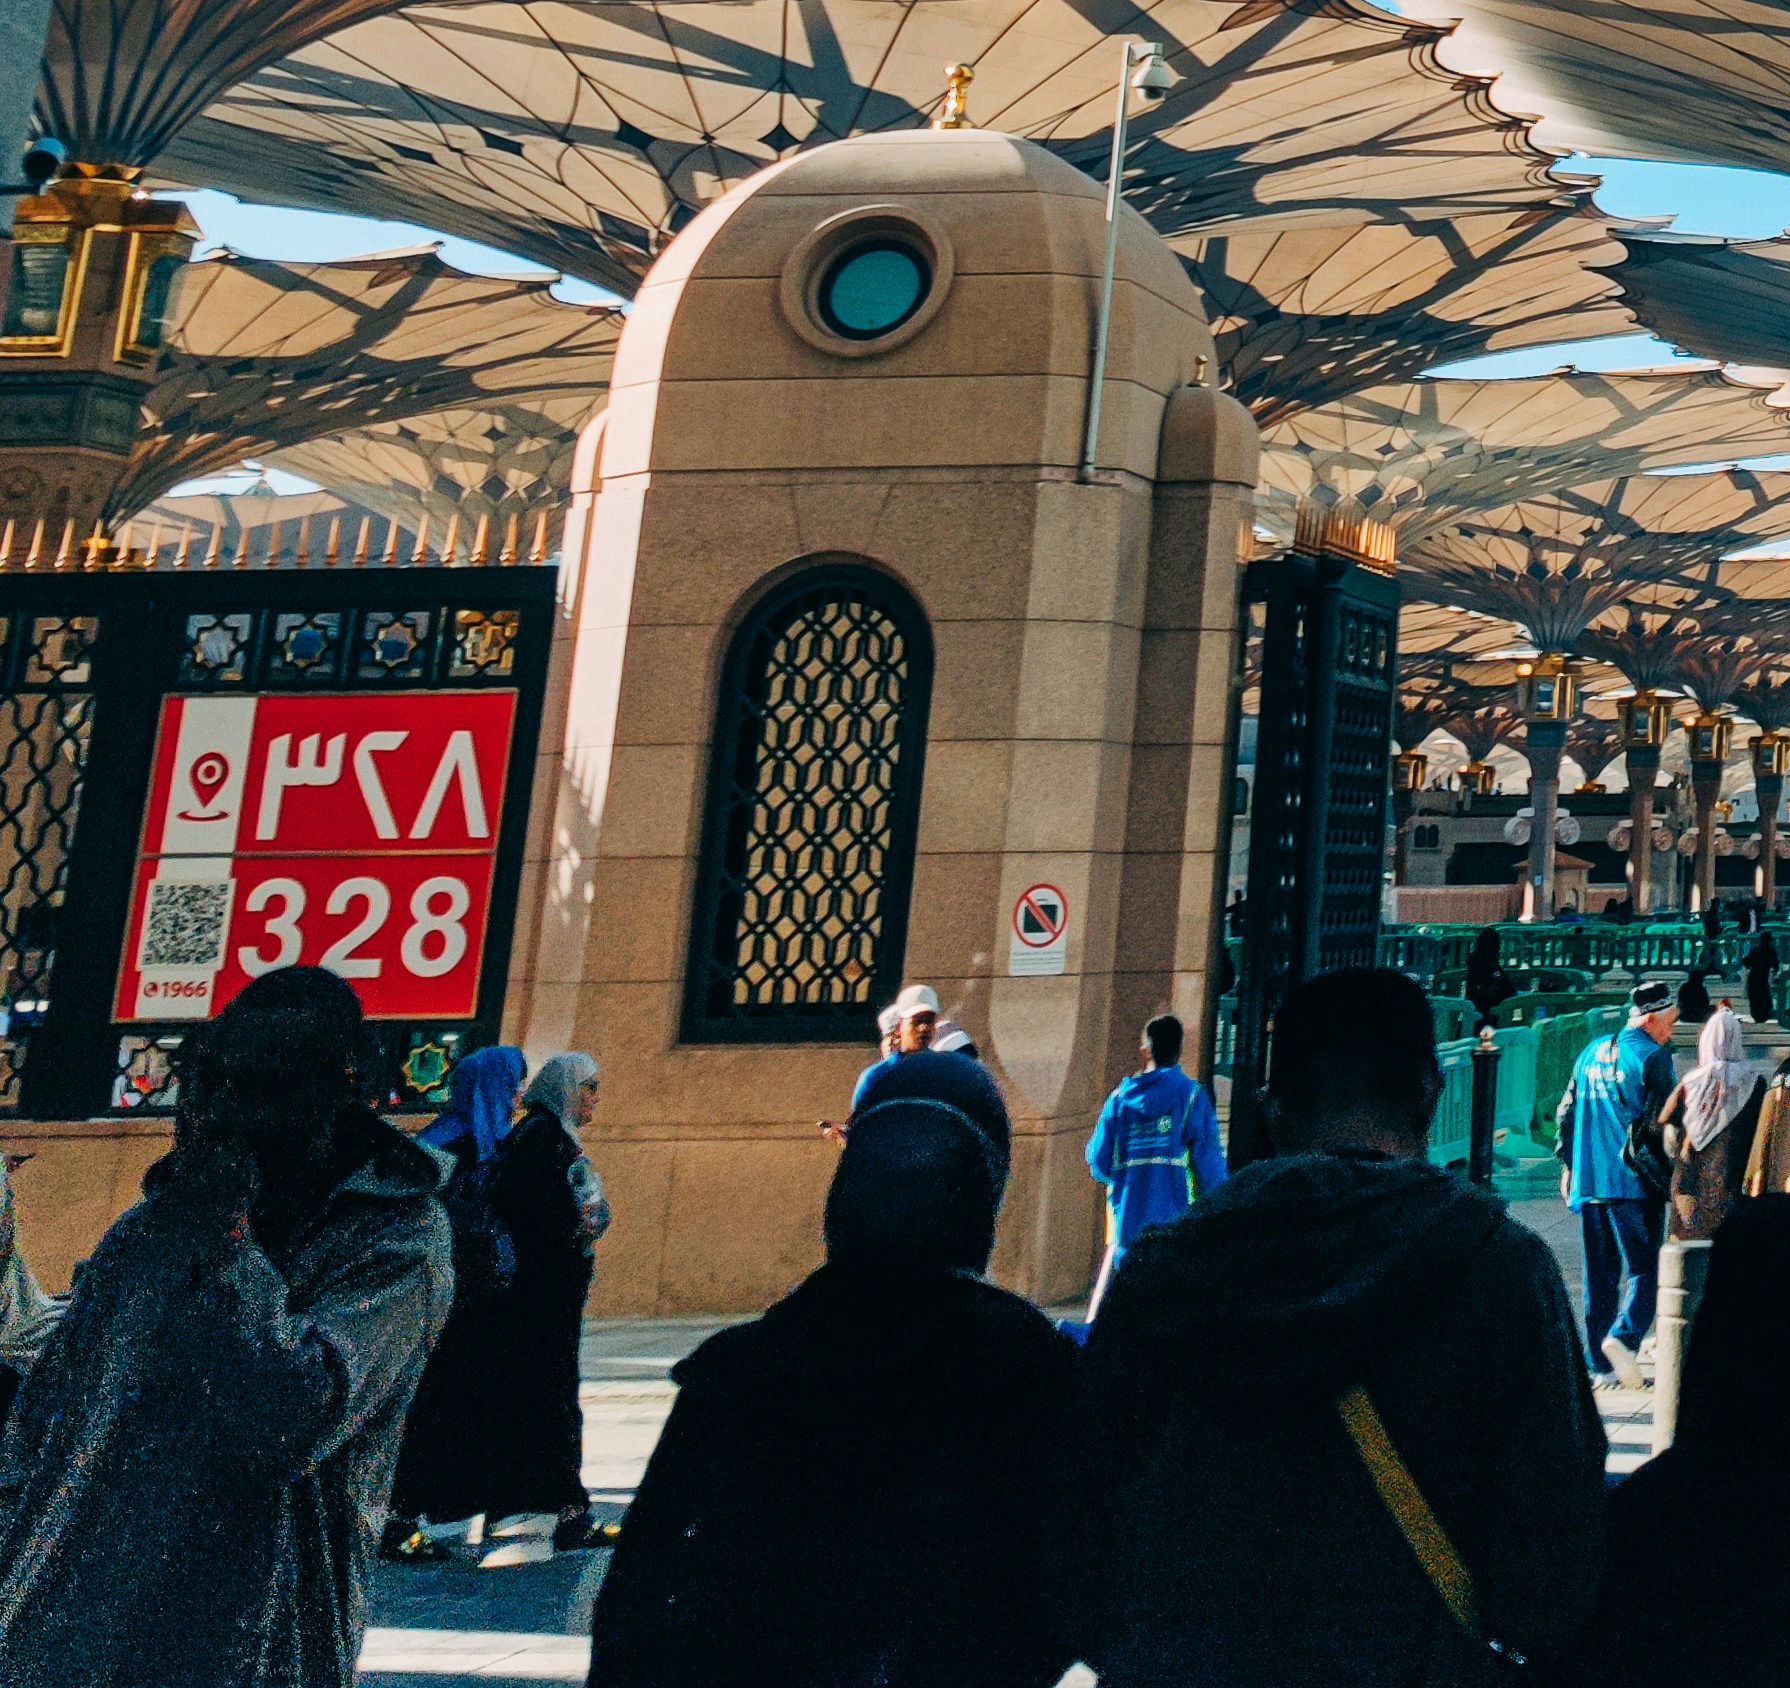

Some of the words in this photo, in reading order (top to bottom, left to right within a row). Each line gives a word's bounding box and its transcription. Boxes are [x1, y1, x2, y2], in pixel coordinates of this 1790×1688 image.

[254, 730, 490, 841] ٣٢٨
[238, 876, 471, 978] 328
[161, 980, 208, 998] 1966
